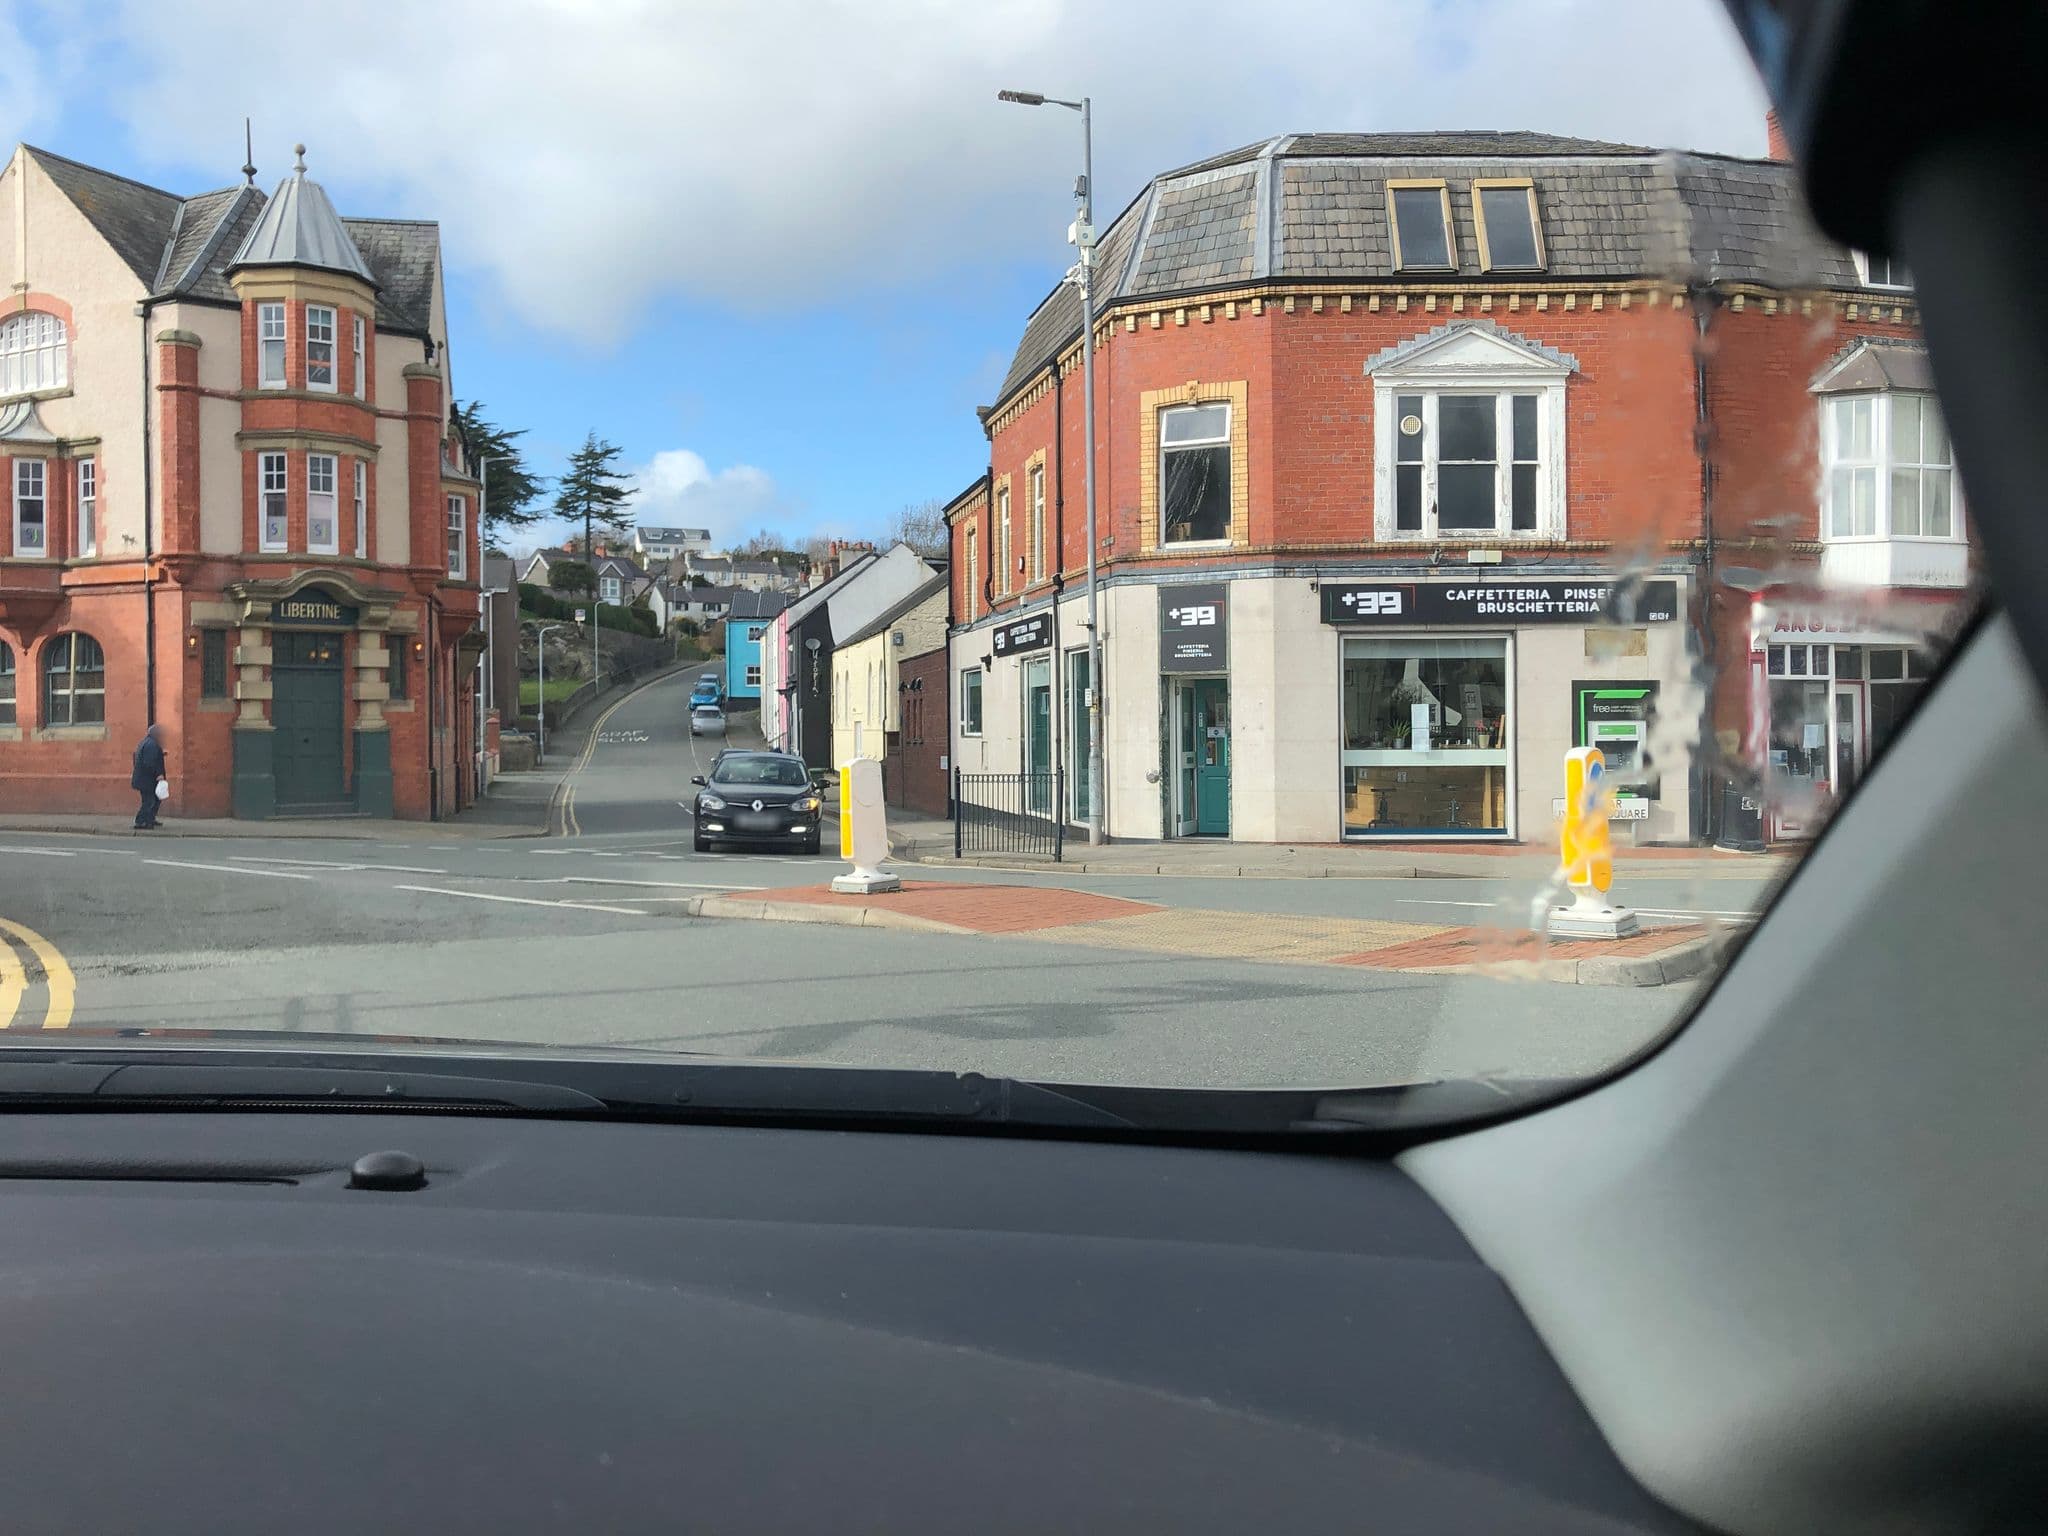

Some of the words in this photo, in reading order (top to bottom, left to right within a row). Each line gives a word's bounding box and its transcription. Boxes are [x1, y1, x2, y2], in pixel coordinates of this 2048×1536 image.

[1446, 589, 1550, 600] CAFFETTERIA
[1564, 588, 1615, 600] PINSE
[1341, 591, 1402, 615] +39
[1477, 601, 1600, 613] BRUSCHETTERIA
[1168, 606, 1216, 626] +39
[1592, 703, 1610, 713] free
